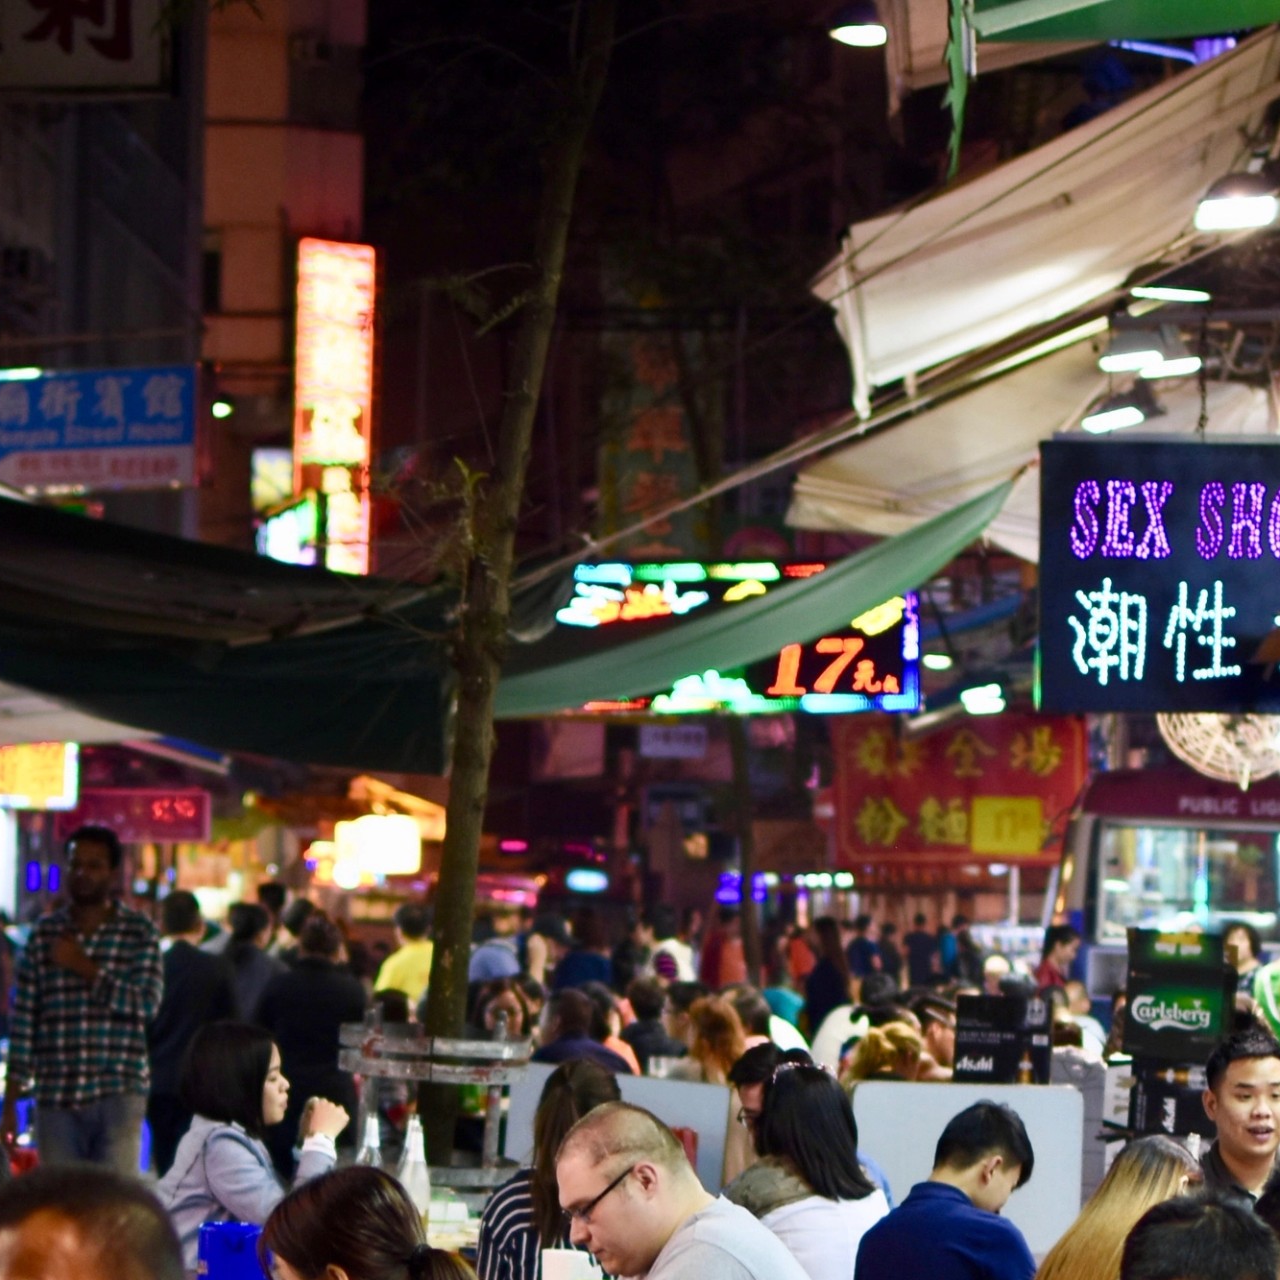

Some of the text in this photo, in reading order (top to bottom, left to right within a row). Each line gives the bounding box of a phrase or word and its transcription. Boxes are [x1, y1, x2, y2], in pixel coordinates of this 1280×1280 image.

[1070, 479, 1173, 560] SEX
[1178, 797, 1239, 814] PUBLIC
[1131, 994, 1212, 1029] Carlsberg
